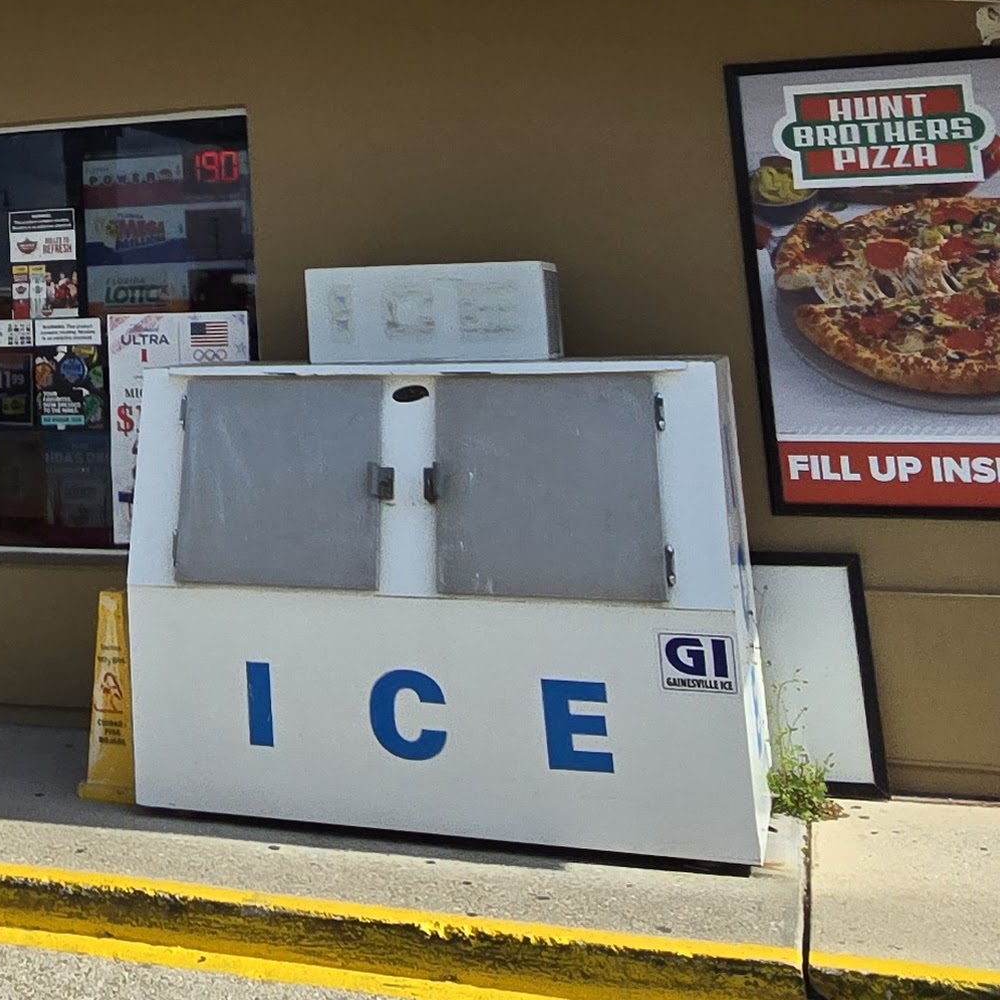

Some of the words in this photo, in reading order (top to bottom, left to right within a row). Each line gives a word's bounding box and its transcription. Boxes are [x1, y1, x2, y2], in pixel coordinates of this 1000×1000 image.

[828, 93, 927, 122] HUNT
[792, 117, 974, 147] BROTHERS
[195, 151, 240, 183] 190
[833, 143, 938, 171] PIZZA
[121, 334, 170, 346] ULTRA
[787, 455, 862, 481] FILL
[867, 456, 922, 482] UP
[665, 637, 729, 678] GI
[666, 677, 719, 690] GAINESVILLE
[720, 681, 734, 691] ICE
[246, 660, 616, 774] ICE
